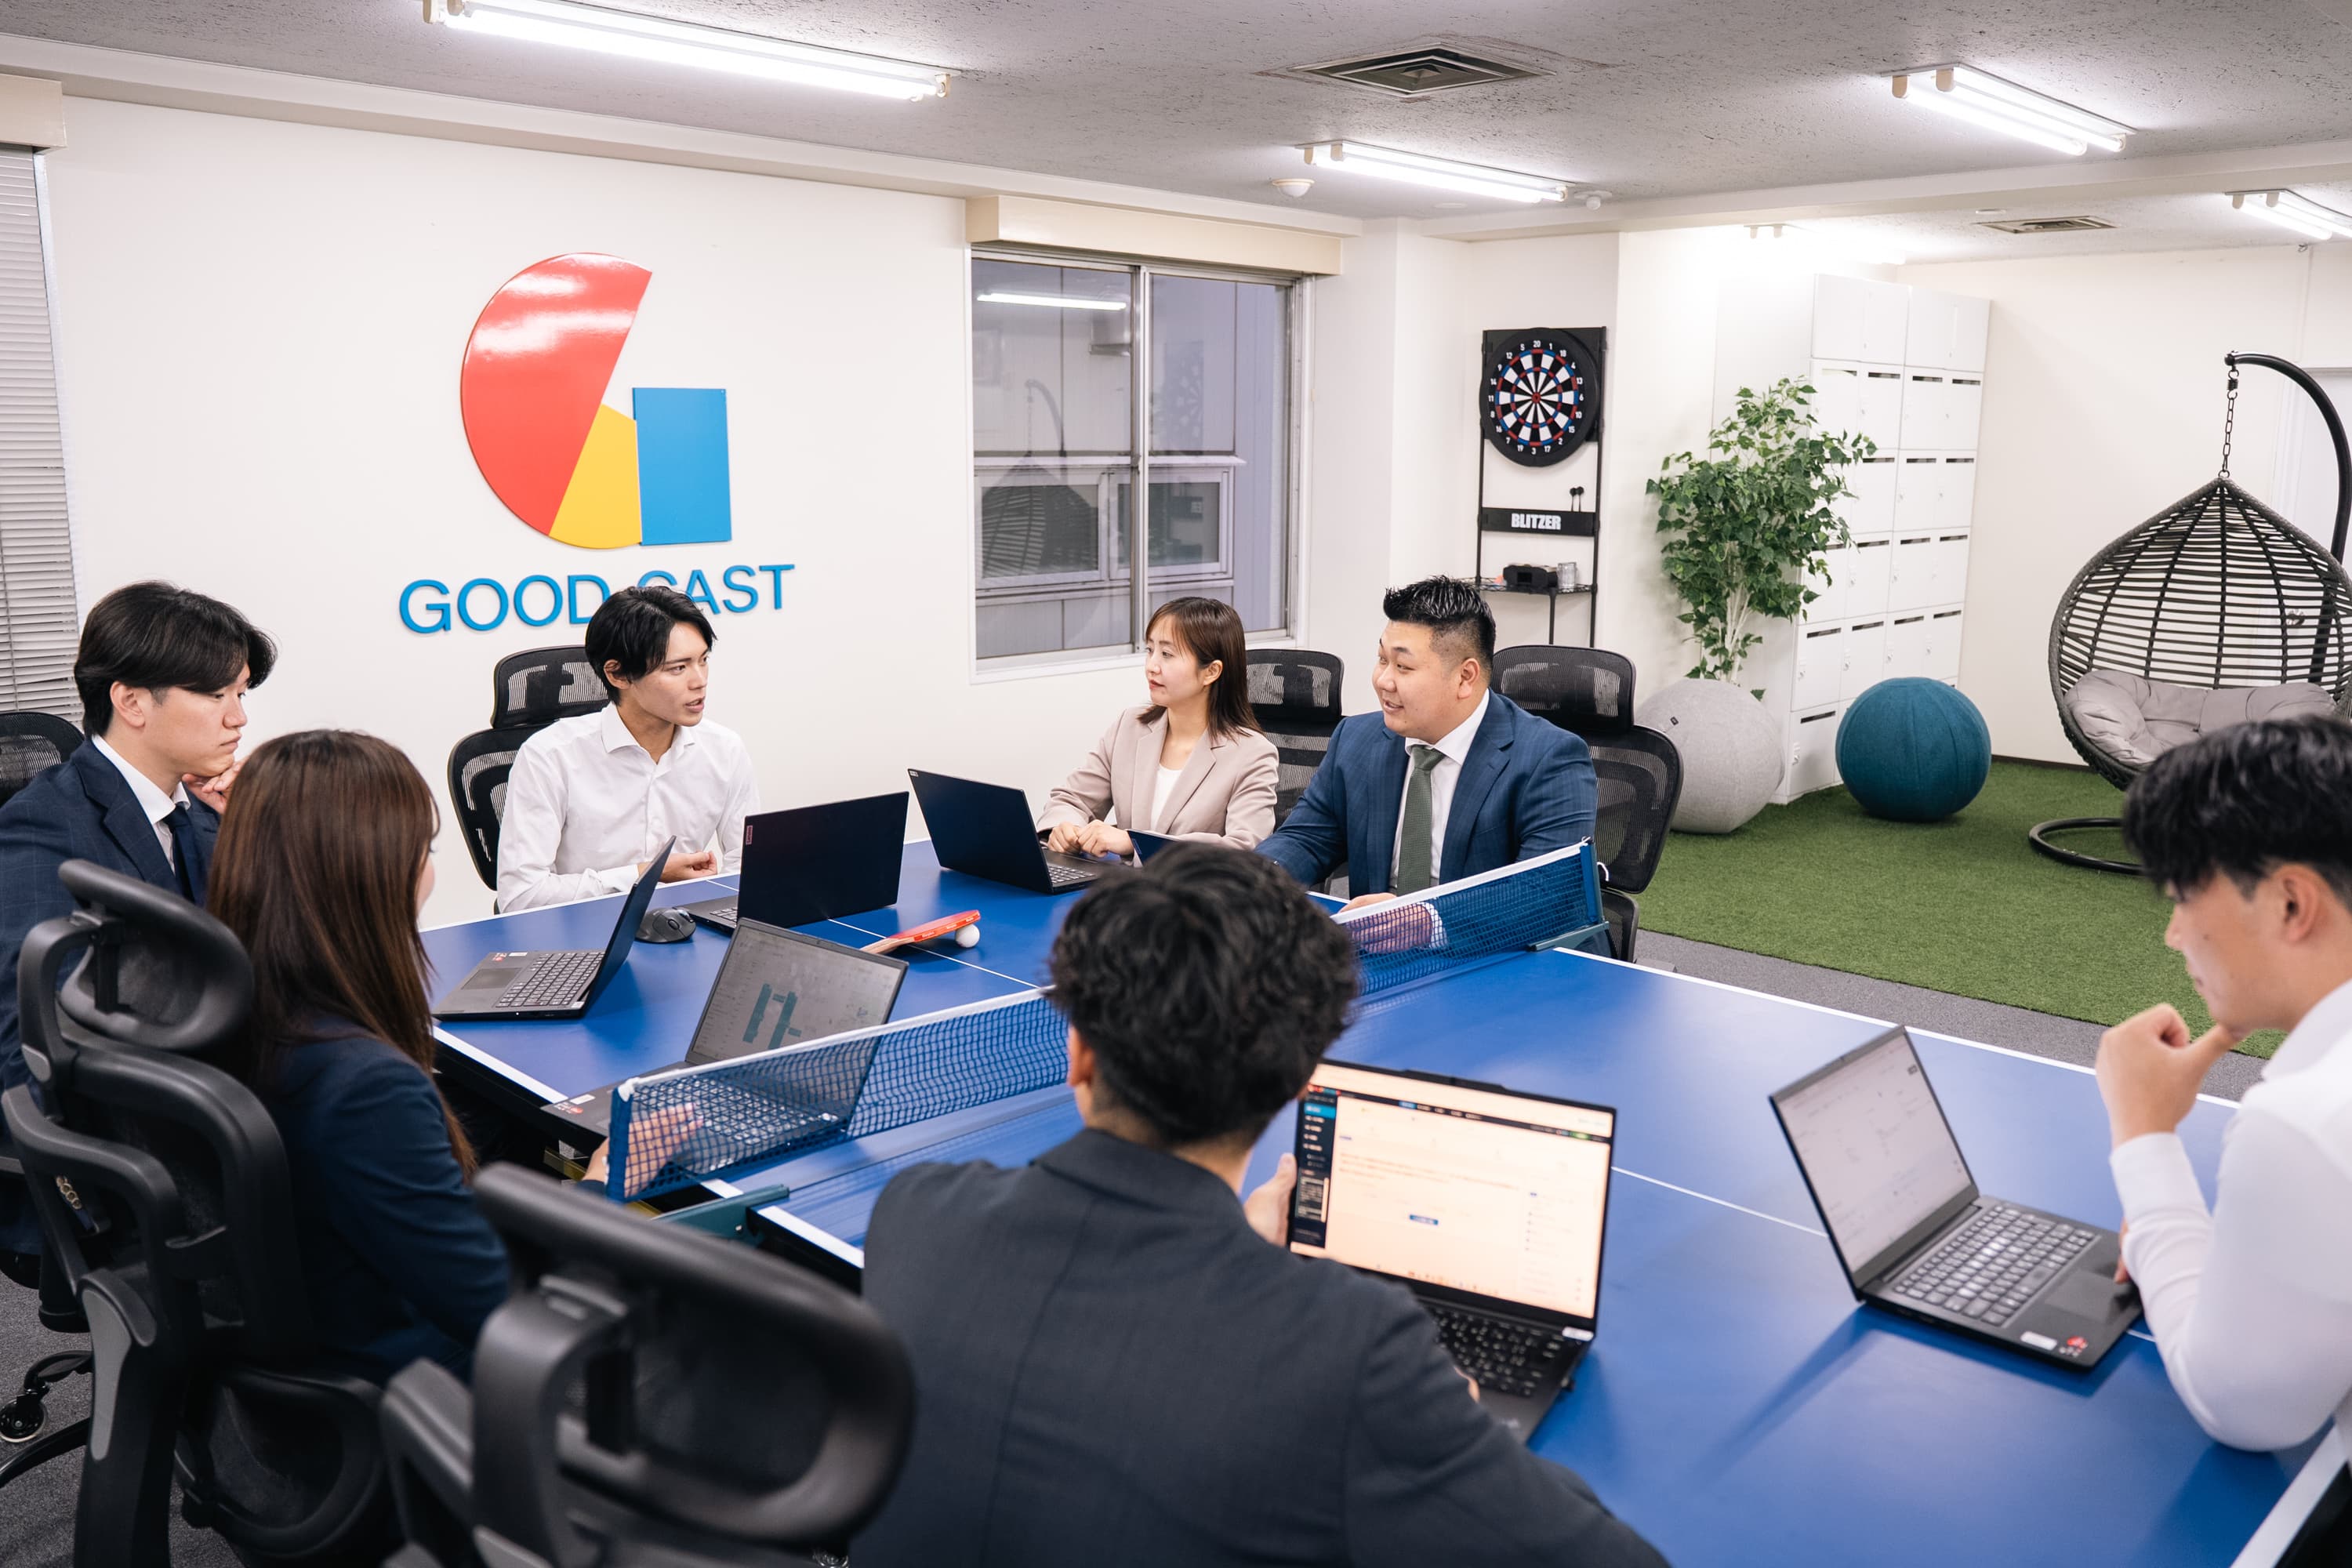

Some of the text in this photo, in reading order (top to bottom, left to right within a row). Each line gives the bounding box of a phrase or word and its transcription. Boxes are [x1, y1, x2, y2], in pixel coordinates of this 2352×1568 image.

[1533, 339, 1541, 348] 20
[1505, 351, 1513, 360] 12
[1576, 376, 1584, 385] 13
[1575, 411, 1583, 419] 10
[1558, 437, 1563, 445] 2
[1531, 447, 1537, 456] 3
[1544, 445, 1552, 453] 17
[1511, 513, 1562, 530] BLITZER
[400, 575, 612, 633] GOOD
